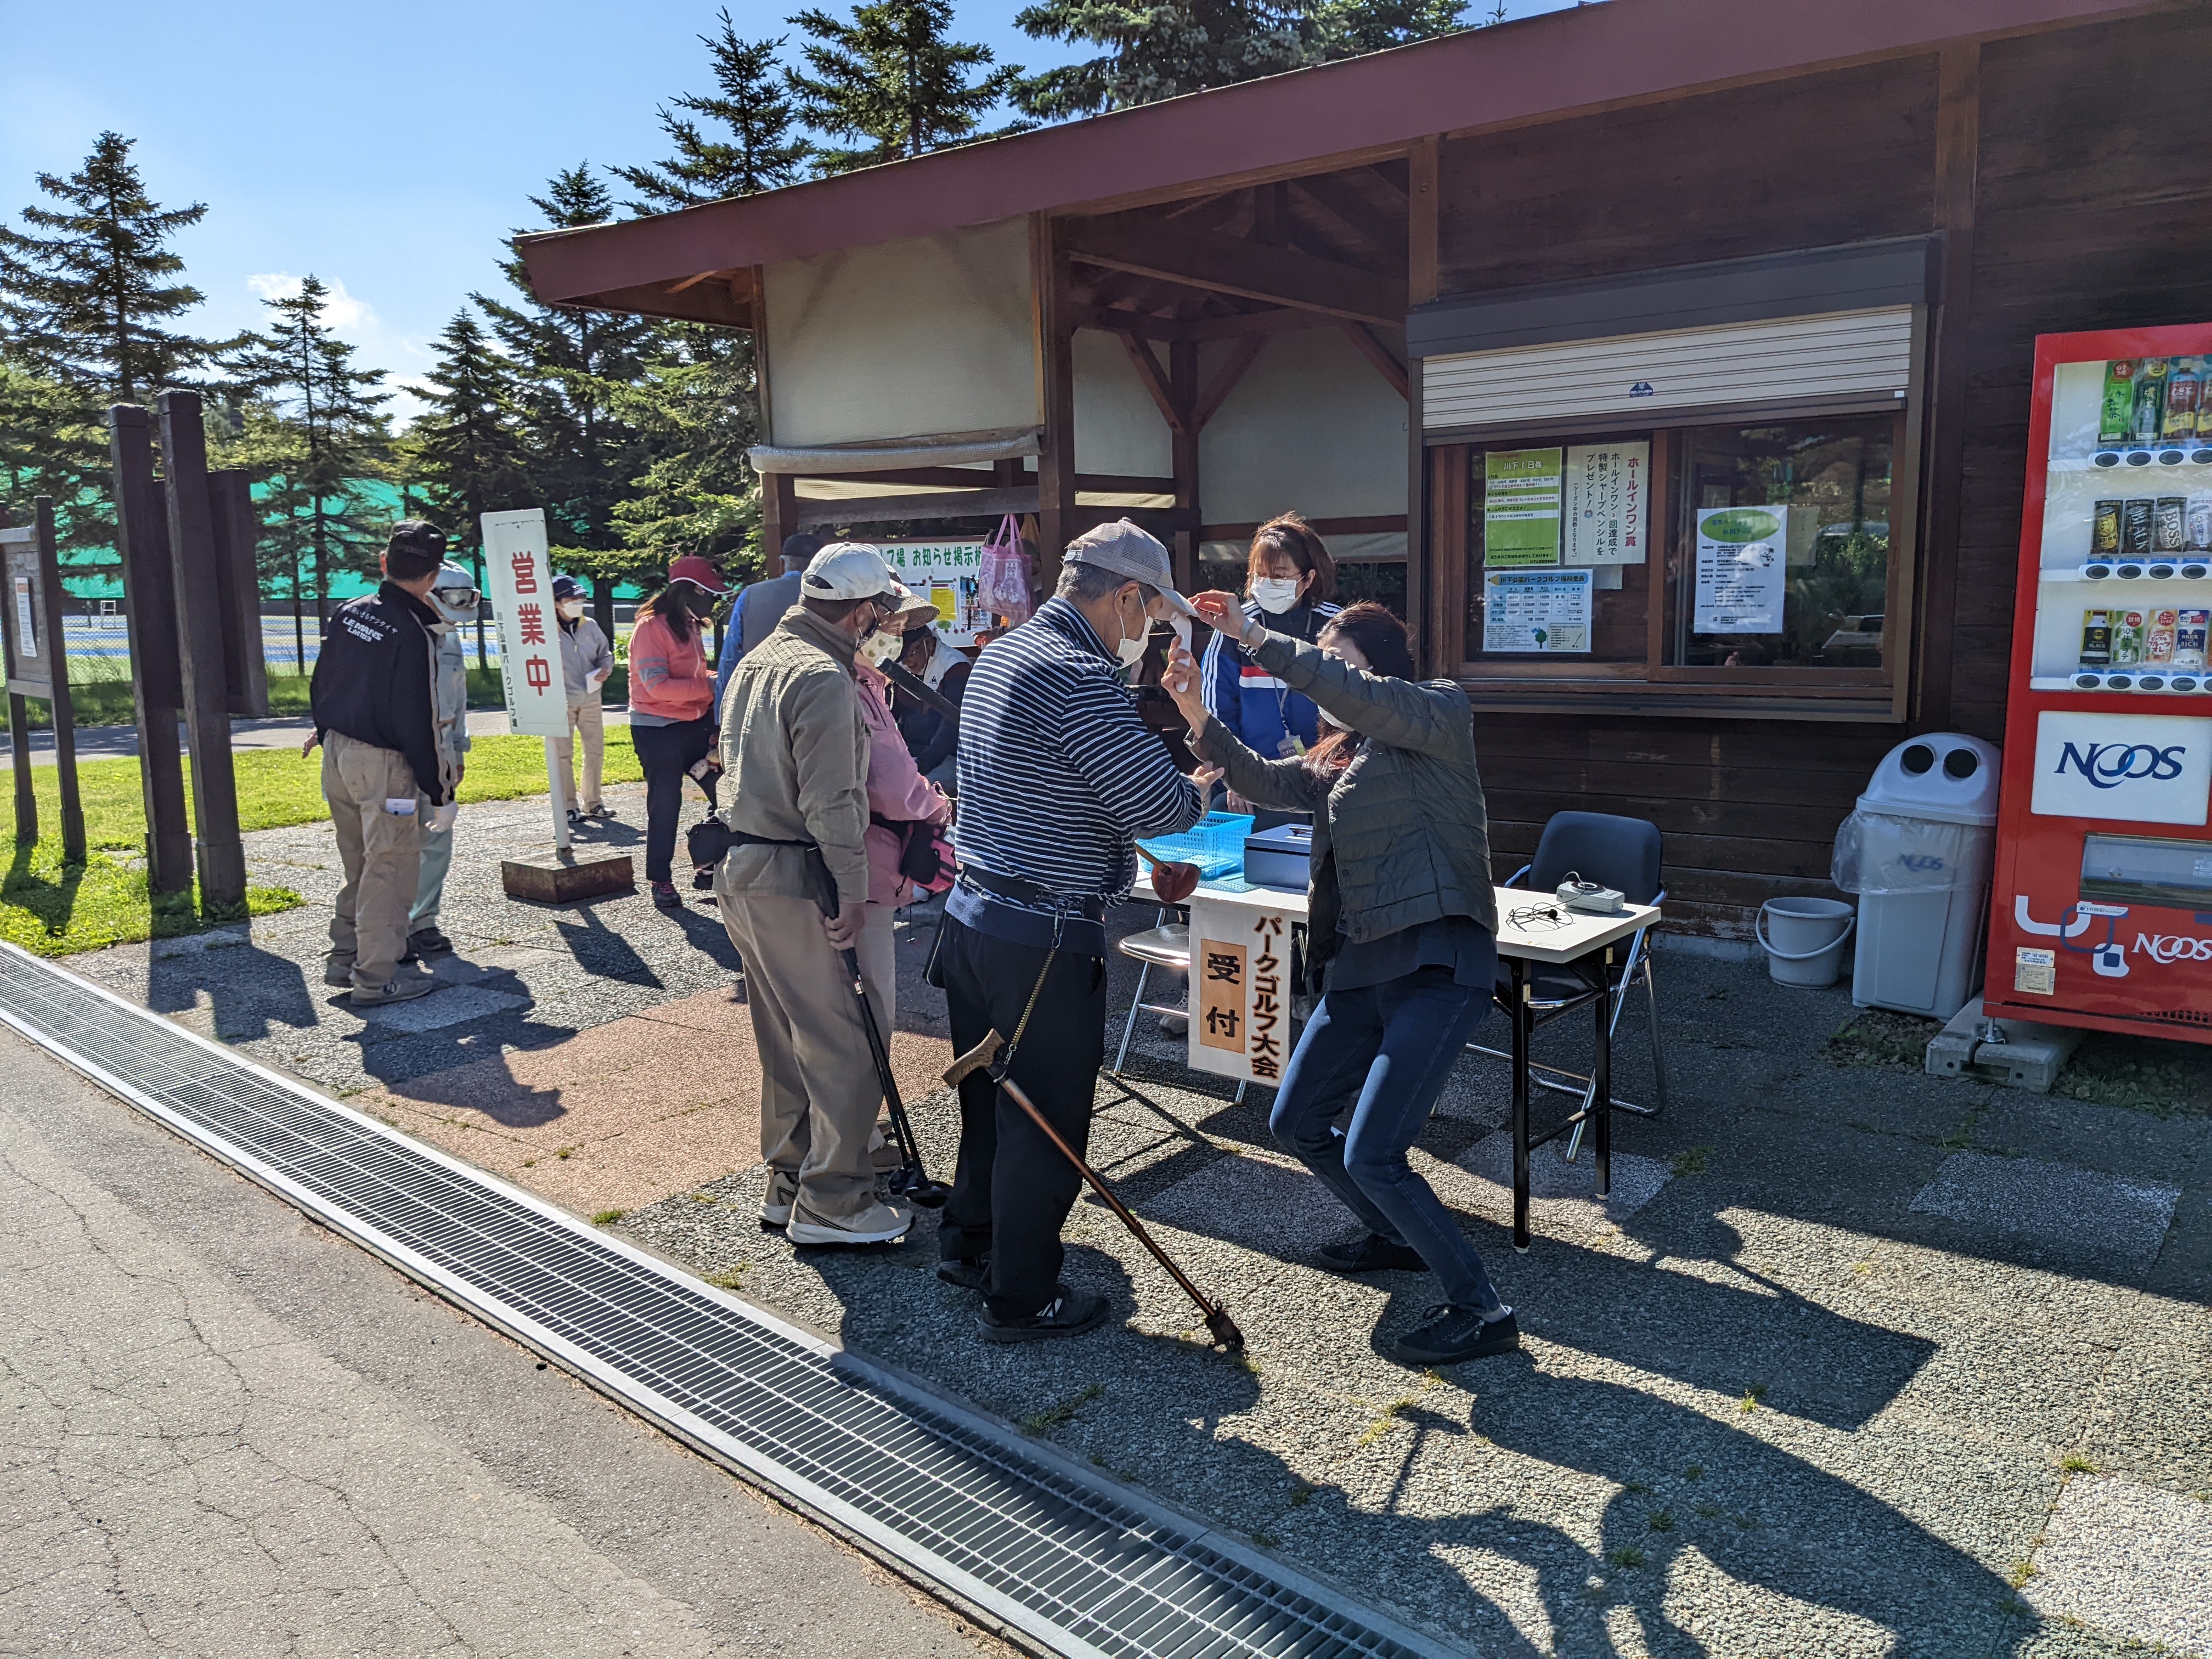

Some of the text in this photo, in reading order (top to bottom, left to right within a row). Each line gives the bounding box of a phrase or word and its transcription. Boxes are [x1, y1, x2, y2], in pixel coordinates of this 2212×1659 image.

[1586, 453, 1595, 508] プレゼント!
[1596, 453, 1608, 556] 特製シャープペンシルを
[1625, 458, 1639, 546] ホールインワン賞
[2131, 509, 2149, 549] BLACK
[2165, 510, 2180, 546] BOSS
[1500, 575, 1585, 583] 川下公園パークゴルフ場料金表
[342, 617, 384, 641] LE MANS
[511, 550, 551, 696] 営業中
[2053, 742, 2186, 789] NOOS
[2131, 933, 2212, 964] NOOS
[1206, 952, 1240, 1038] 受付
[1251, 915, 1283, 1079] パークゴルフ大会
